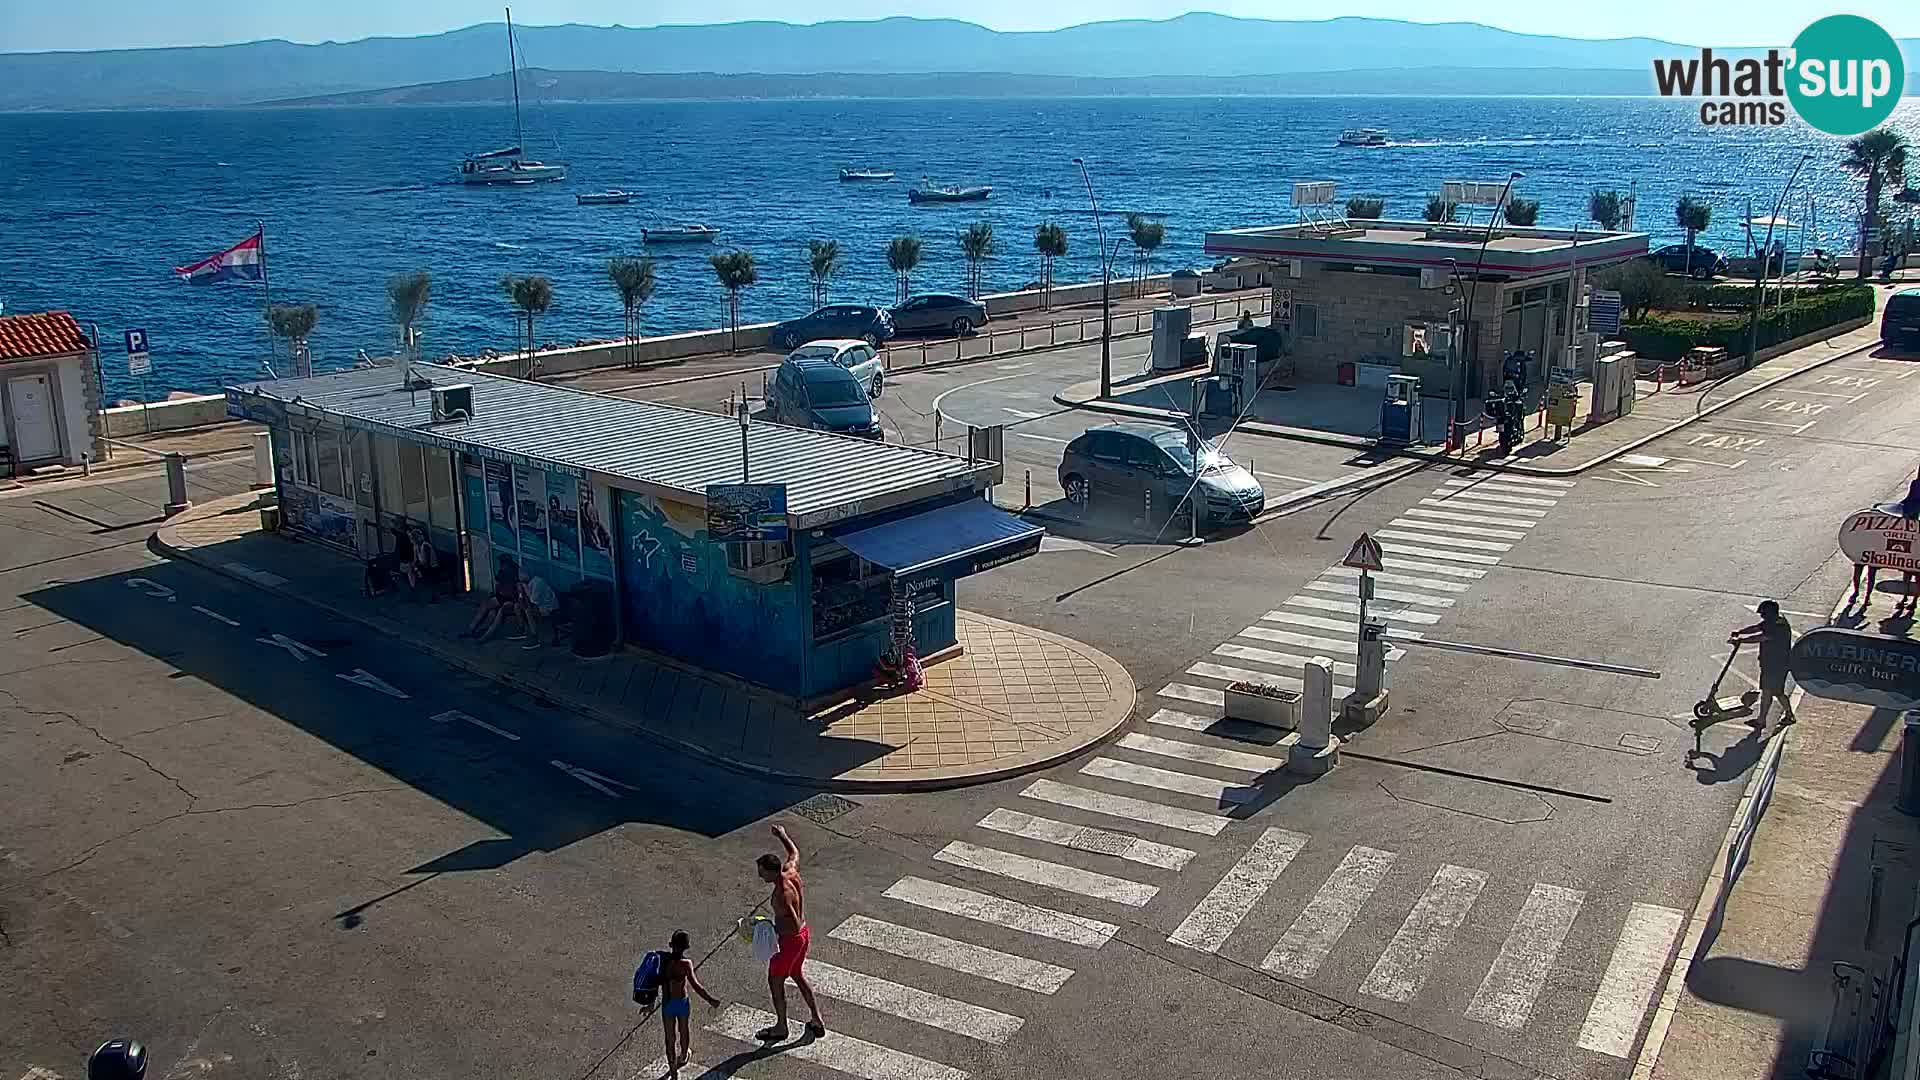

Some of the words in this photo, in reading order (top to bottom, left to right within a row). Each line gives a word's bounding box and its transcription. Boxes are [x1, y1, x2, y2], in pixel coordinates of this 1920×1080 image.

[130, 332, 142, 351] P
[1815, 374, 1883, 389] TAXI
[1759, 399, 1833, 416] TAXI
[1687, 433, 1766, 452] TAXI
[494, 450, 526, 465] STATION
[528, 458, 554, 472] TICKET
[555, 464, 585, 479] OFFICE
[1849, 515, 1920, 535] PIZZE
[1804, 638, 1920, 673] MARINER
[1871, 667, 1897, 681] bar
